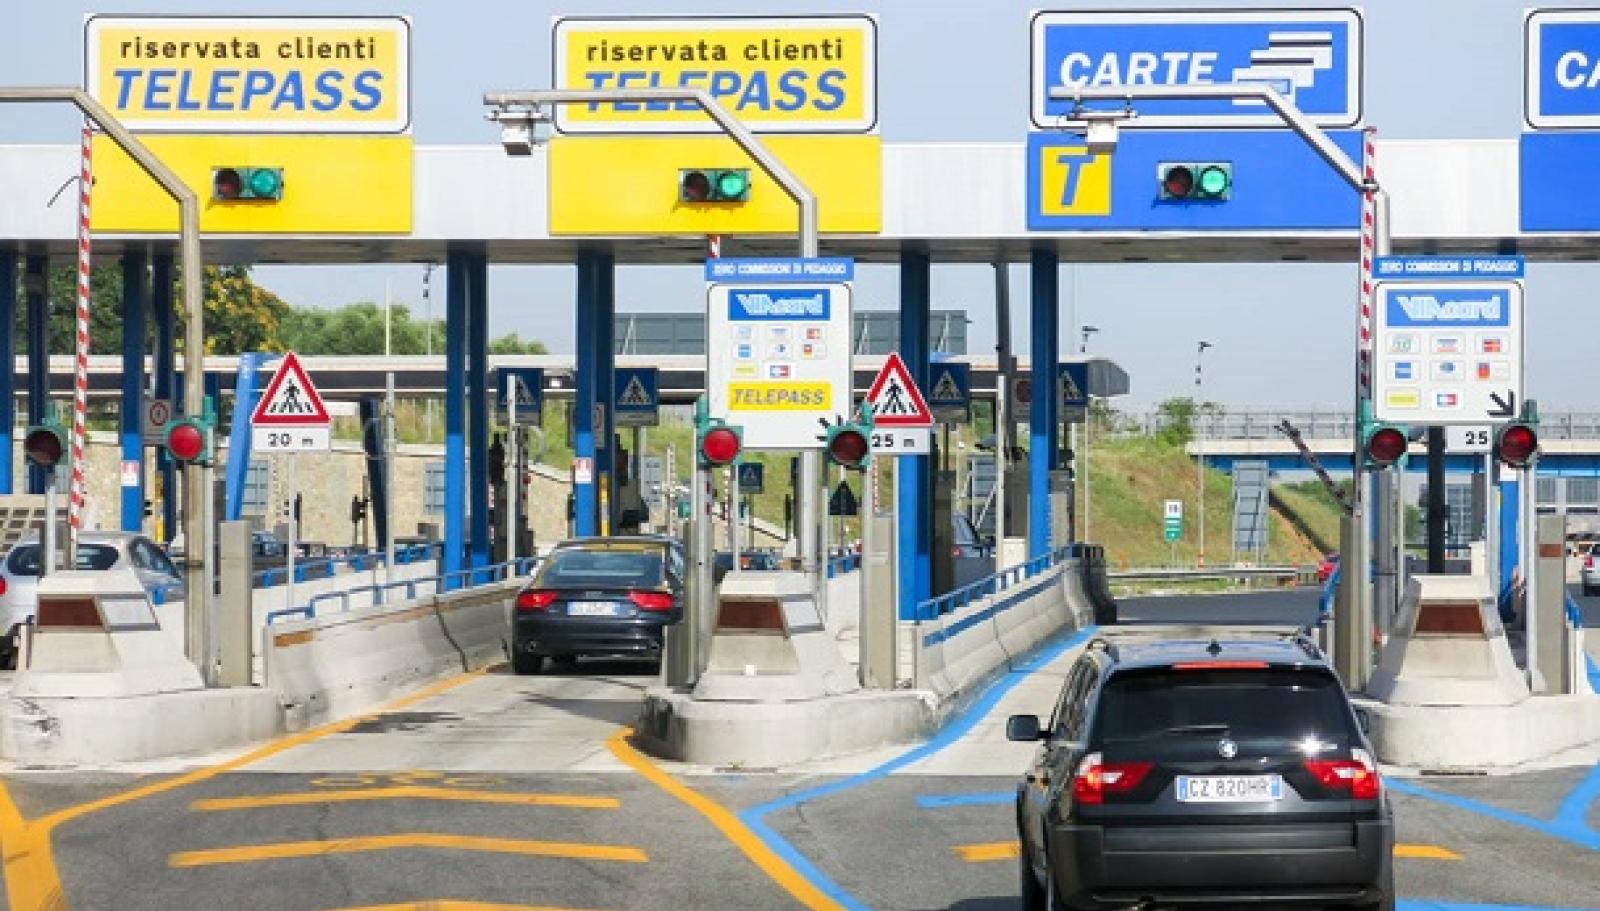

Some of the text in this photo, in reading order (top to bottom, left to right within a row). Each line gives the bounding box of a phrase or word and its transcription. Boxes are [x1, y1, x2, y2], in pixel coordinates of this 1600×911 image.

[120, 37, 376, 58] riservata clienti
[586, 38, 843, 61] riservata clienti
[1059, 51, 1219, 87] CARTE
[113, 69, 383, 111] TELEPASS
[585, 70, 847, 112] TELEPASS
[1057, 155, 1095, 206] T
[734, 388, 826, 405] TELEPASS
[871, 433, 894, 448] 25
[1465, 430, 1488, 446] 25
